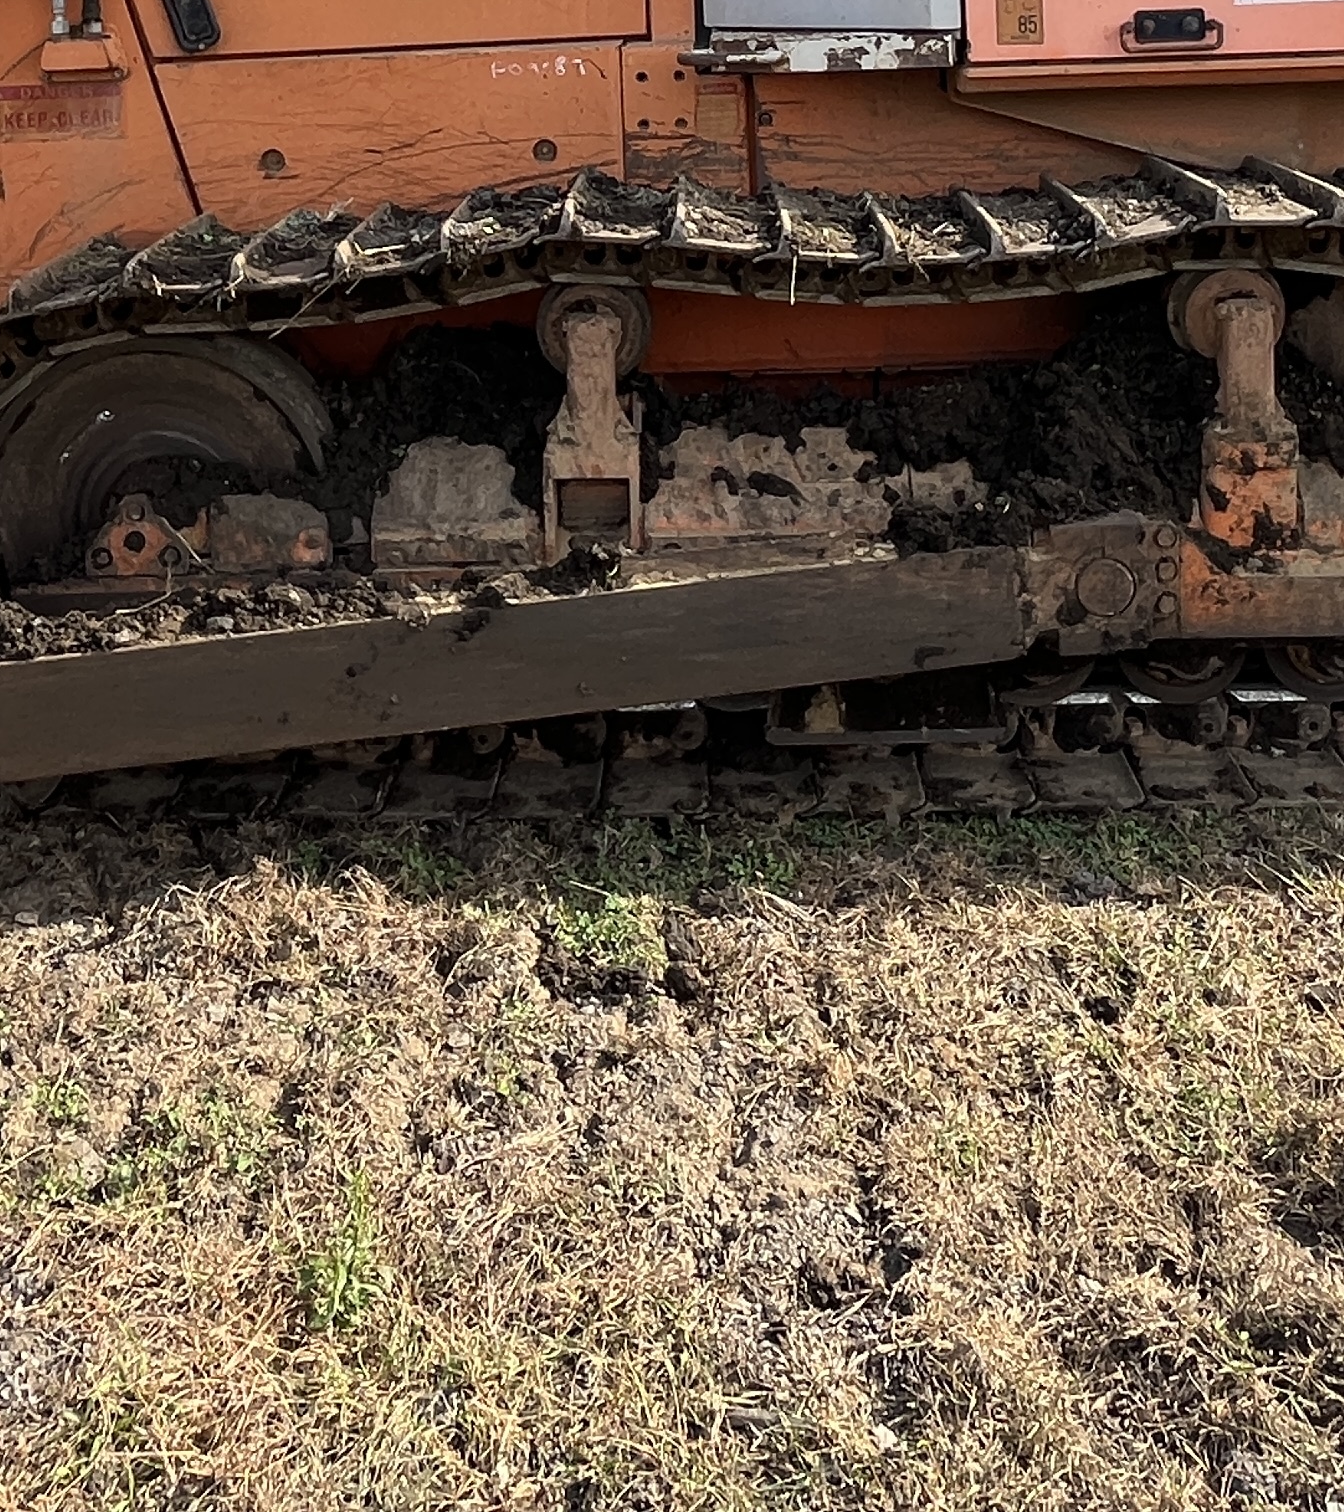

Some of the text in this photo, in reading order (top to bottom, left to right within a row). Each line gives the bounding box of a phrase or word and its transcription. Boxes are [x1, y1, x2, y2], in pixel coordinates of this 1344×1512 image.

[1017, 14, 1038, 34] 85
[20, 85, 94, 99] DANGER
[4, 107, 114, 130] KEEP CLEAR
